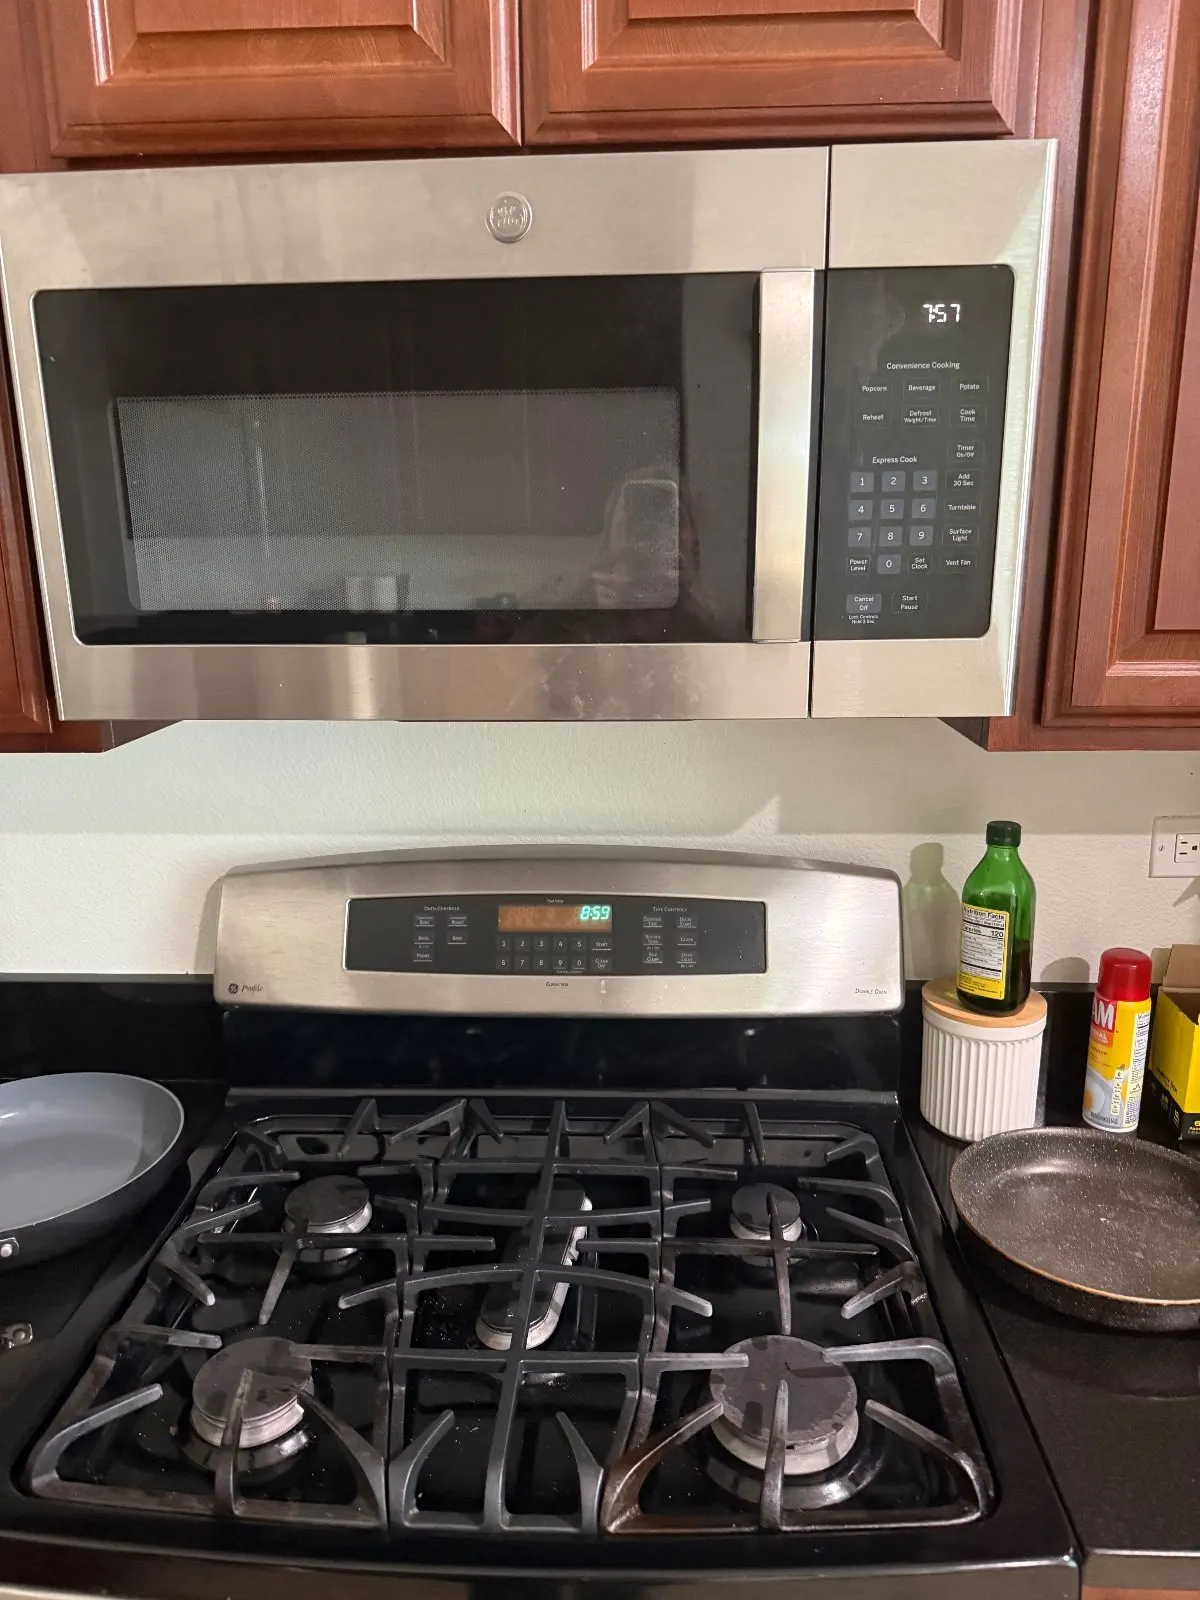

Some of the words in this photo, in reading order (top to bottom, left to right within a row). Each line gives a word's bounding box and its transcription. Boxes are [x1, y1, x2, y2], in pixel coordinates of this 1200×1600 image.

[922, 303, 961, 323] 7:57
[888, 532, 893, 540] 8
[580, 906, 610, 920] 8:59
